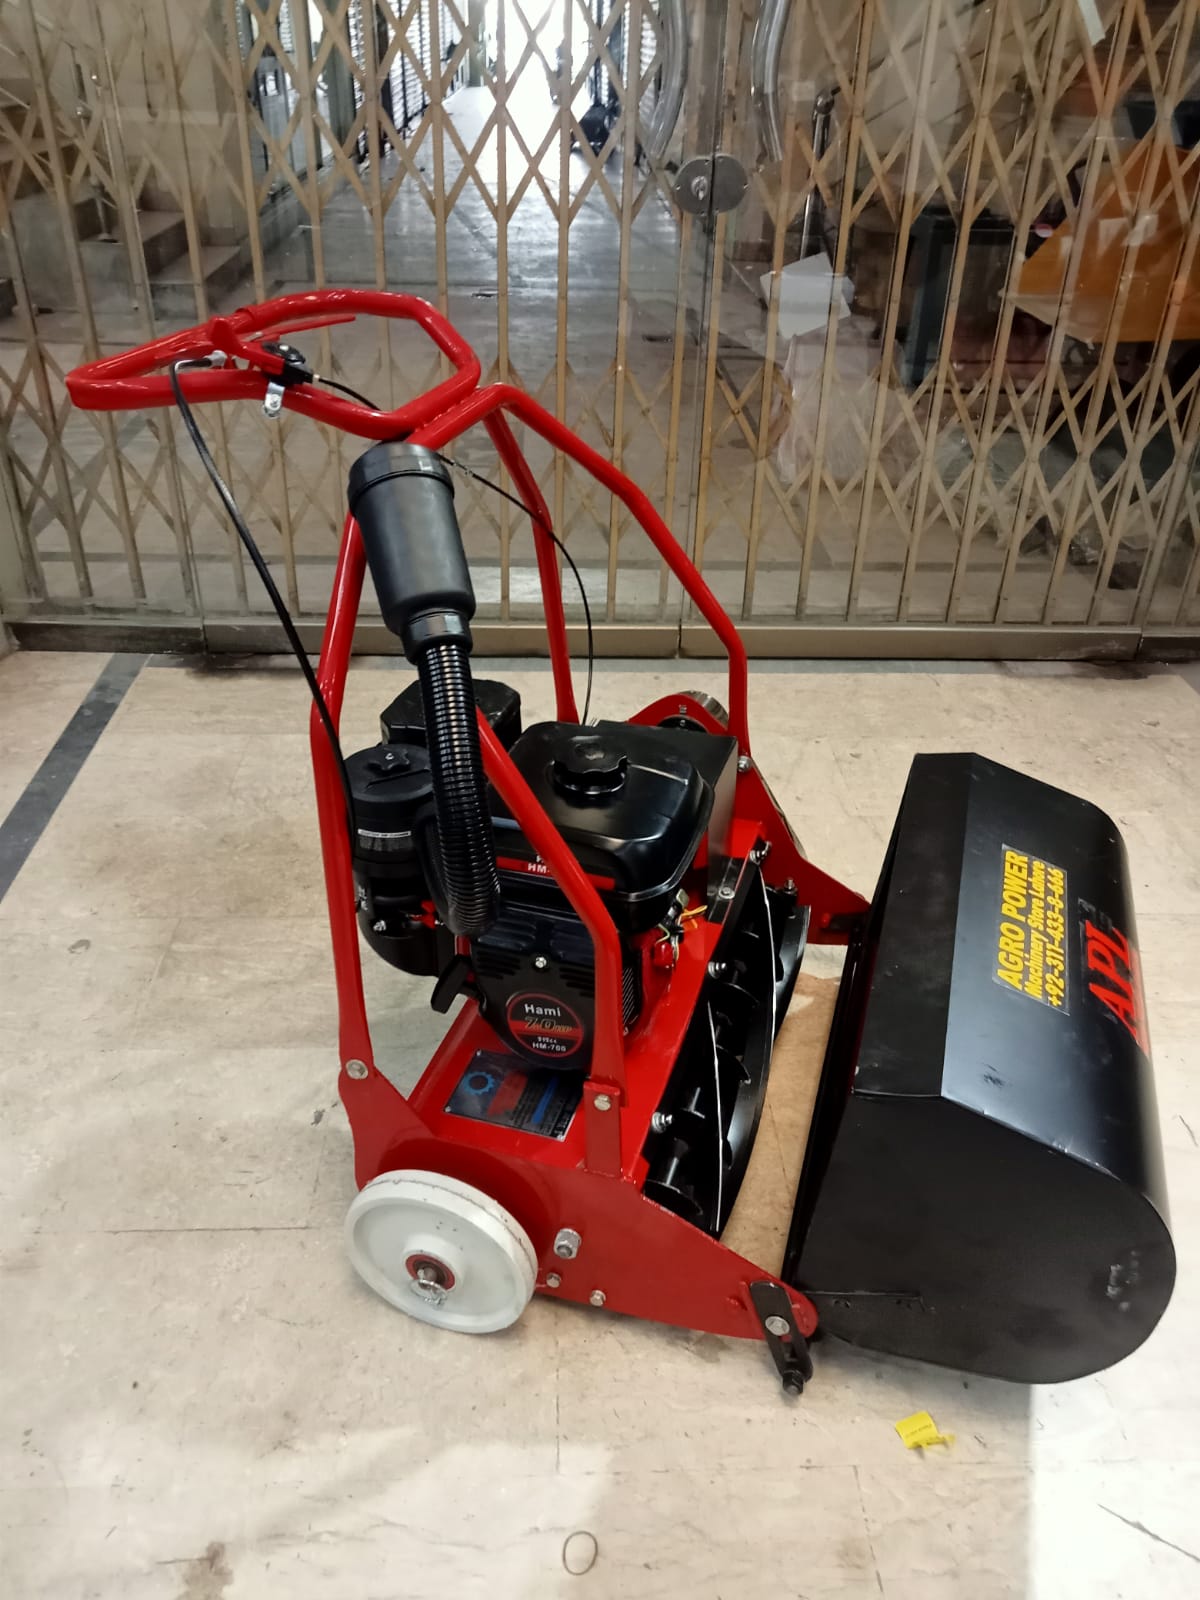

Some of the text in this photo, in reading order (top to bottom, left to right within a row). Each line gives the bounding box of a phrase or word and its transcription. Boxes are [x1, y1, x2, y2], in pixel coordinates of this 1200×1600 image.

[997, 850, 1029, 991] AGRO POWER
[1024, 860, 1050, 1000] Machinery Store Lahore
[1045, 867, 1065, 1008] +92-311-433-8-666
[1084, 920, 1138, 1038] APL
[524, 1003, 561, 1017] Hami
